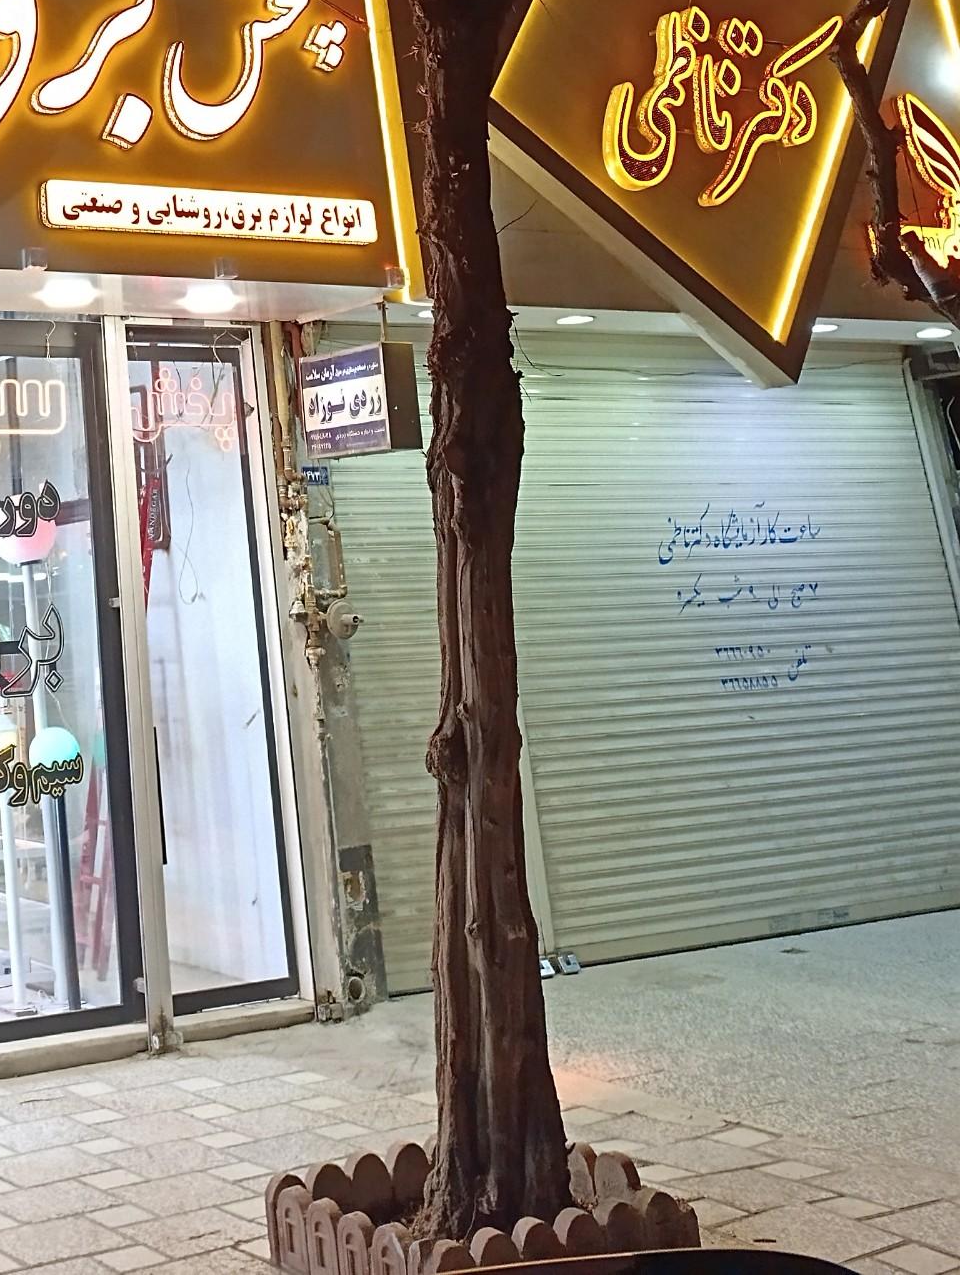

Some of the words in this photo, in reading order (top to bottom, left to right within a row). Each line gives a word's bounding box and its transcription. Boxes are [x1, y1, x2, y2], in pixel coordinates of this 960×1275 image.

[603, 6, 741, 191] ناظمی
[697, 15, 844, 207] دکتر
[62, 192, 123, 221] صنعتی
[131, 203, 140, 224] و
[268, 202, 313, 233] لوازم
[320, 205, 362, 236] انواع
[31, 752, 84, 805] سیم
